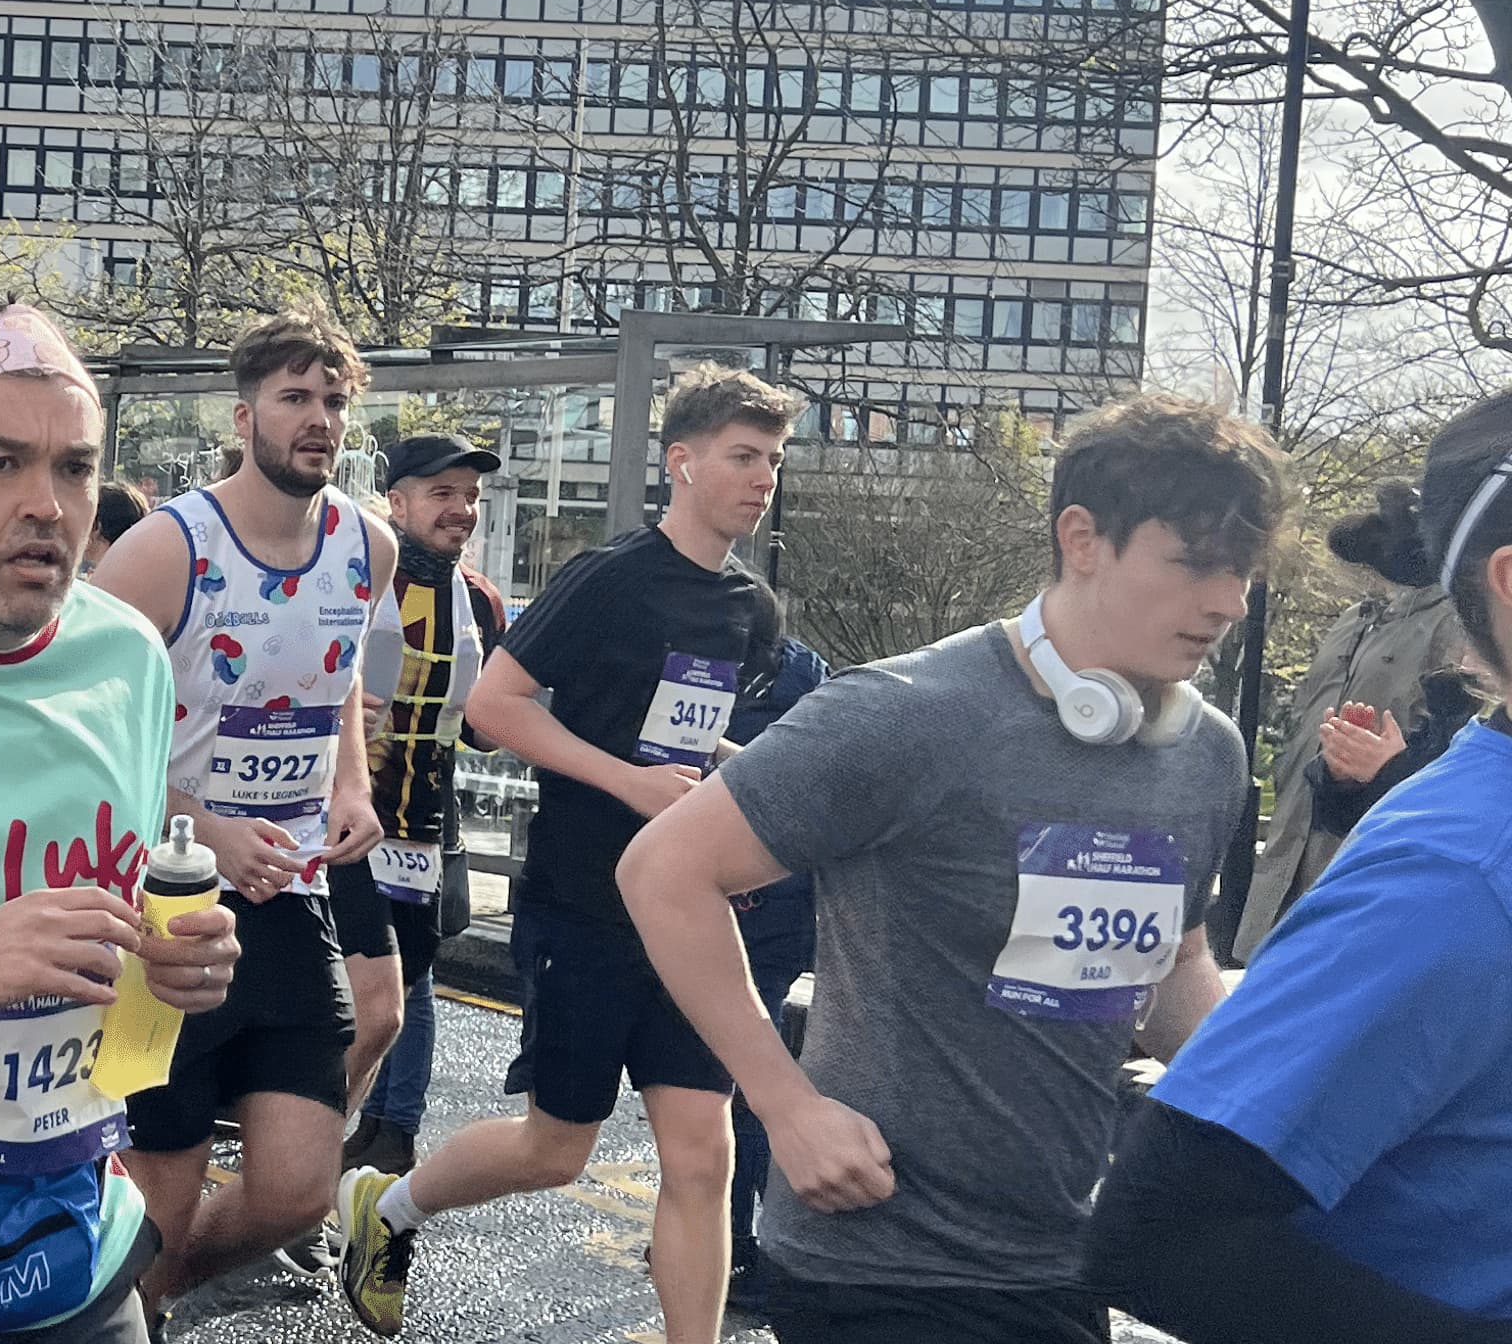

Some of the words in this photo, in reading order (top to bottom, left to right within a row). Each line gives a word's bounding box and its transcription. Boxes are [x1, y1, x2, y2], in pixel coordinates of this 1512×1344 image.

[670, 700, 721, 731] 3417
[238, 754, 319, 782] 3927
[381, 847, 430, 872] 1150
[1053, 905, 1161, 954] 3396
[1080, 966, 1112, 981] BRAD
[4, 1029, 104, 1101] 1423
[33, 1107, 70, 1133] PETER
